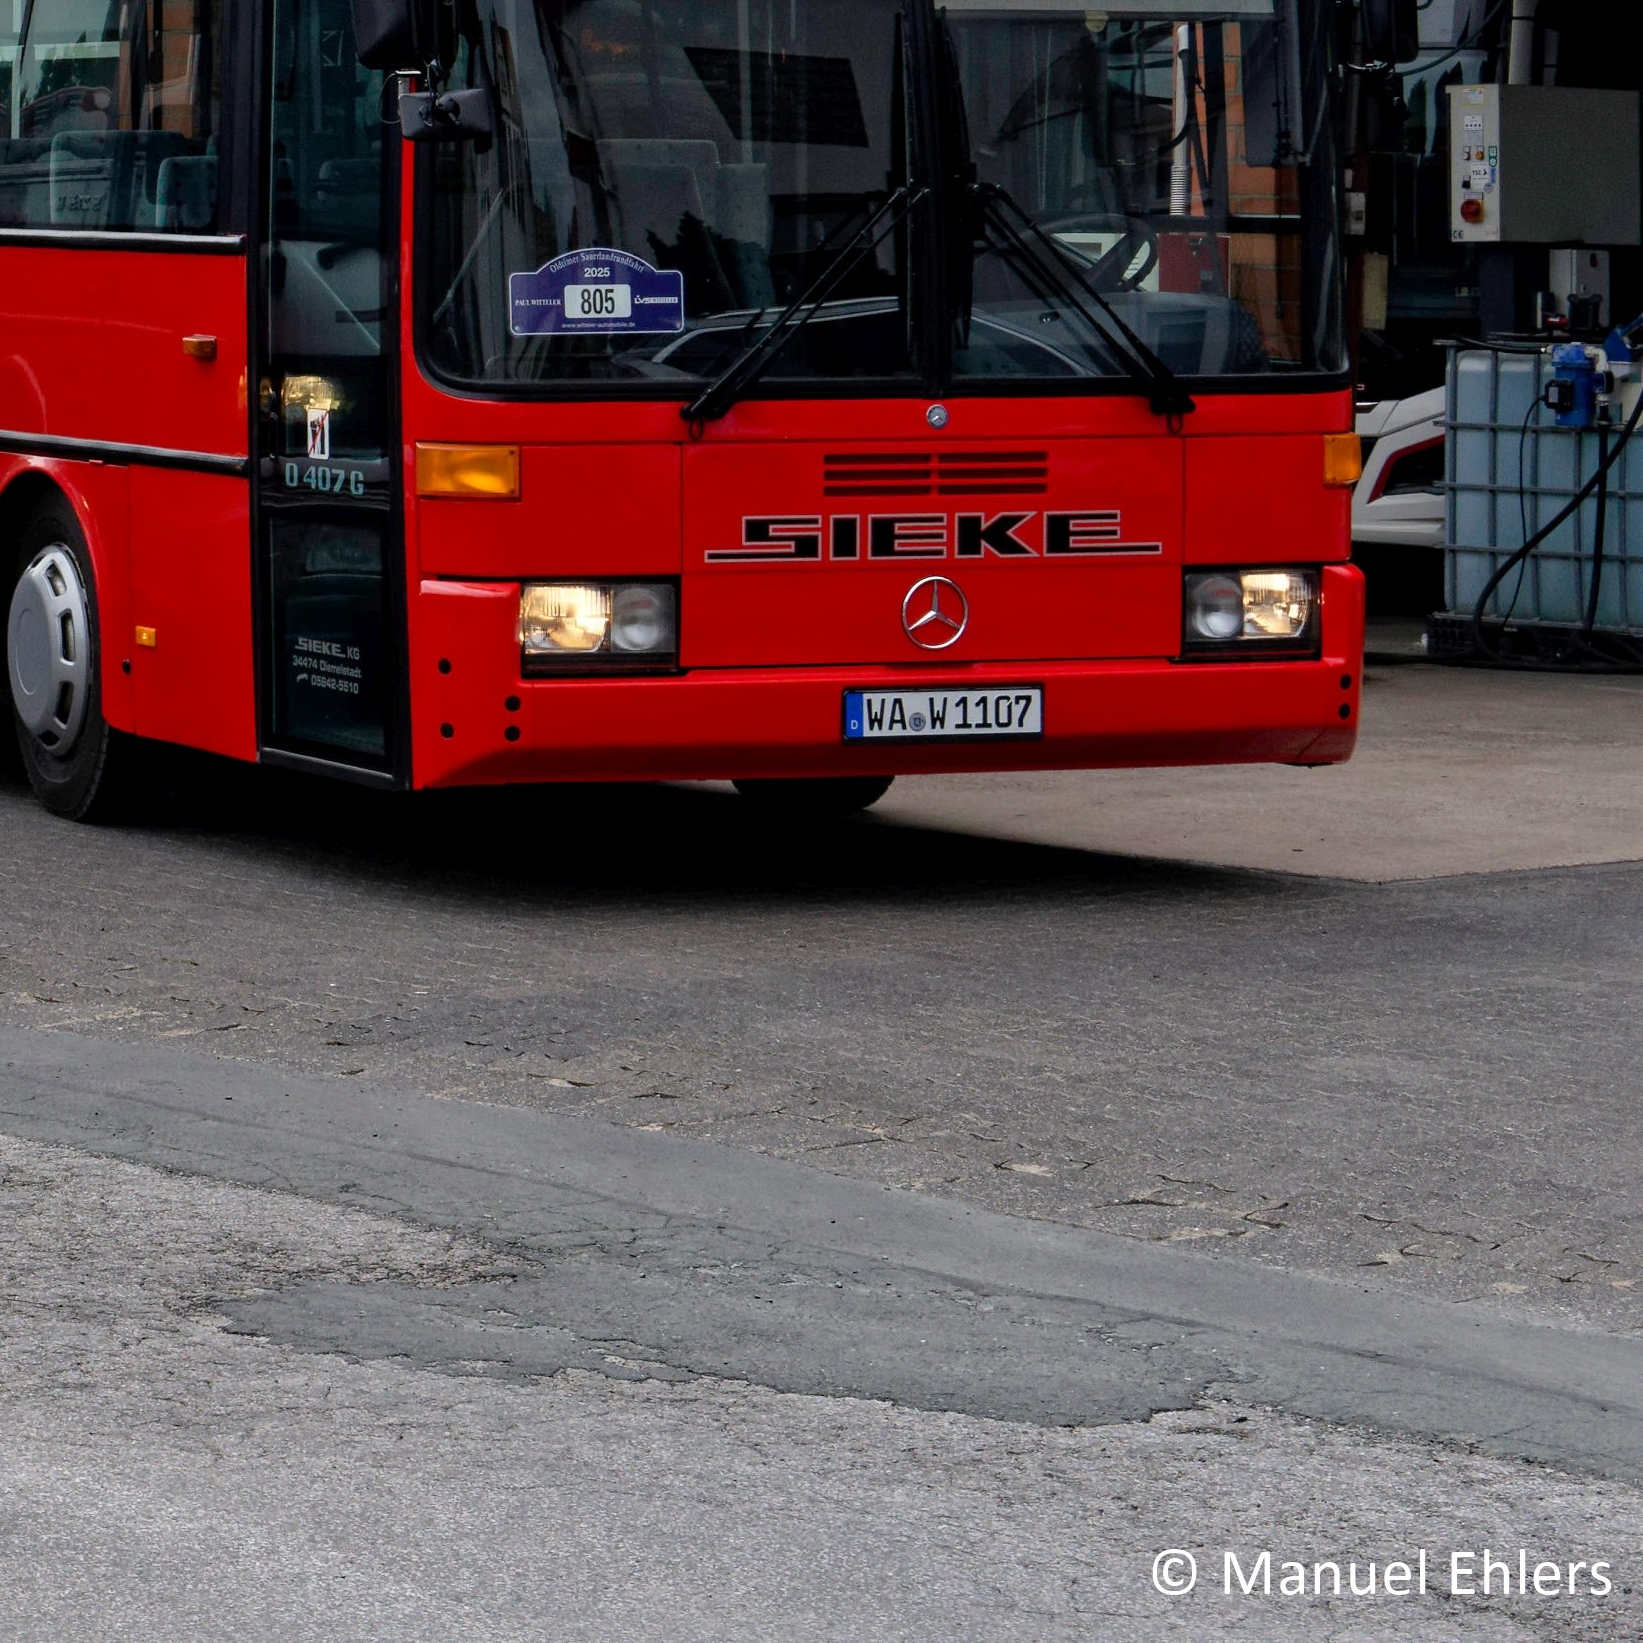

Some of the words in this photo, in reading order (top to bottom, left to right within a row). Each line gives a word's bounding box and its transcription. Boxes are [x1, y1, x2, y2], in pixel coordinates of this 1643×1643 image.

[549, 256, 580, 273] Oldtimer
[580, 252, 645, 273] Sauerlandrundfahrt
[584, 267, 611, 278] 2025
[581, 288, 615, 315] 805
[303, 465, 345, 493] 407
[350, 470, 364, 495] G
[704, 510, 1162, 562] SIEKE
[294, 637, 346, 658] SIEKE
[347, 646, 360, 660] KG
[292, 655, 318, 669] 34474
[866, 698, 908, 731] WA
[928, 697, 948, 730] W
[954, 695, 1033, 729] 1107
